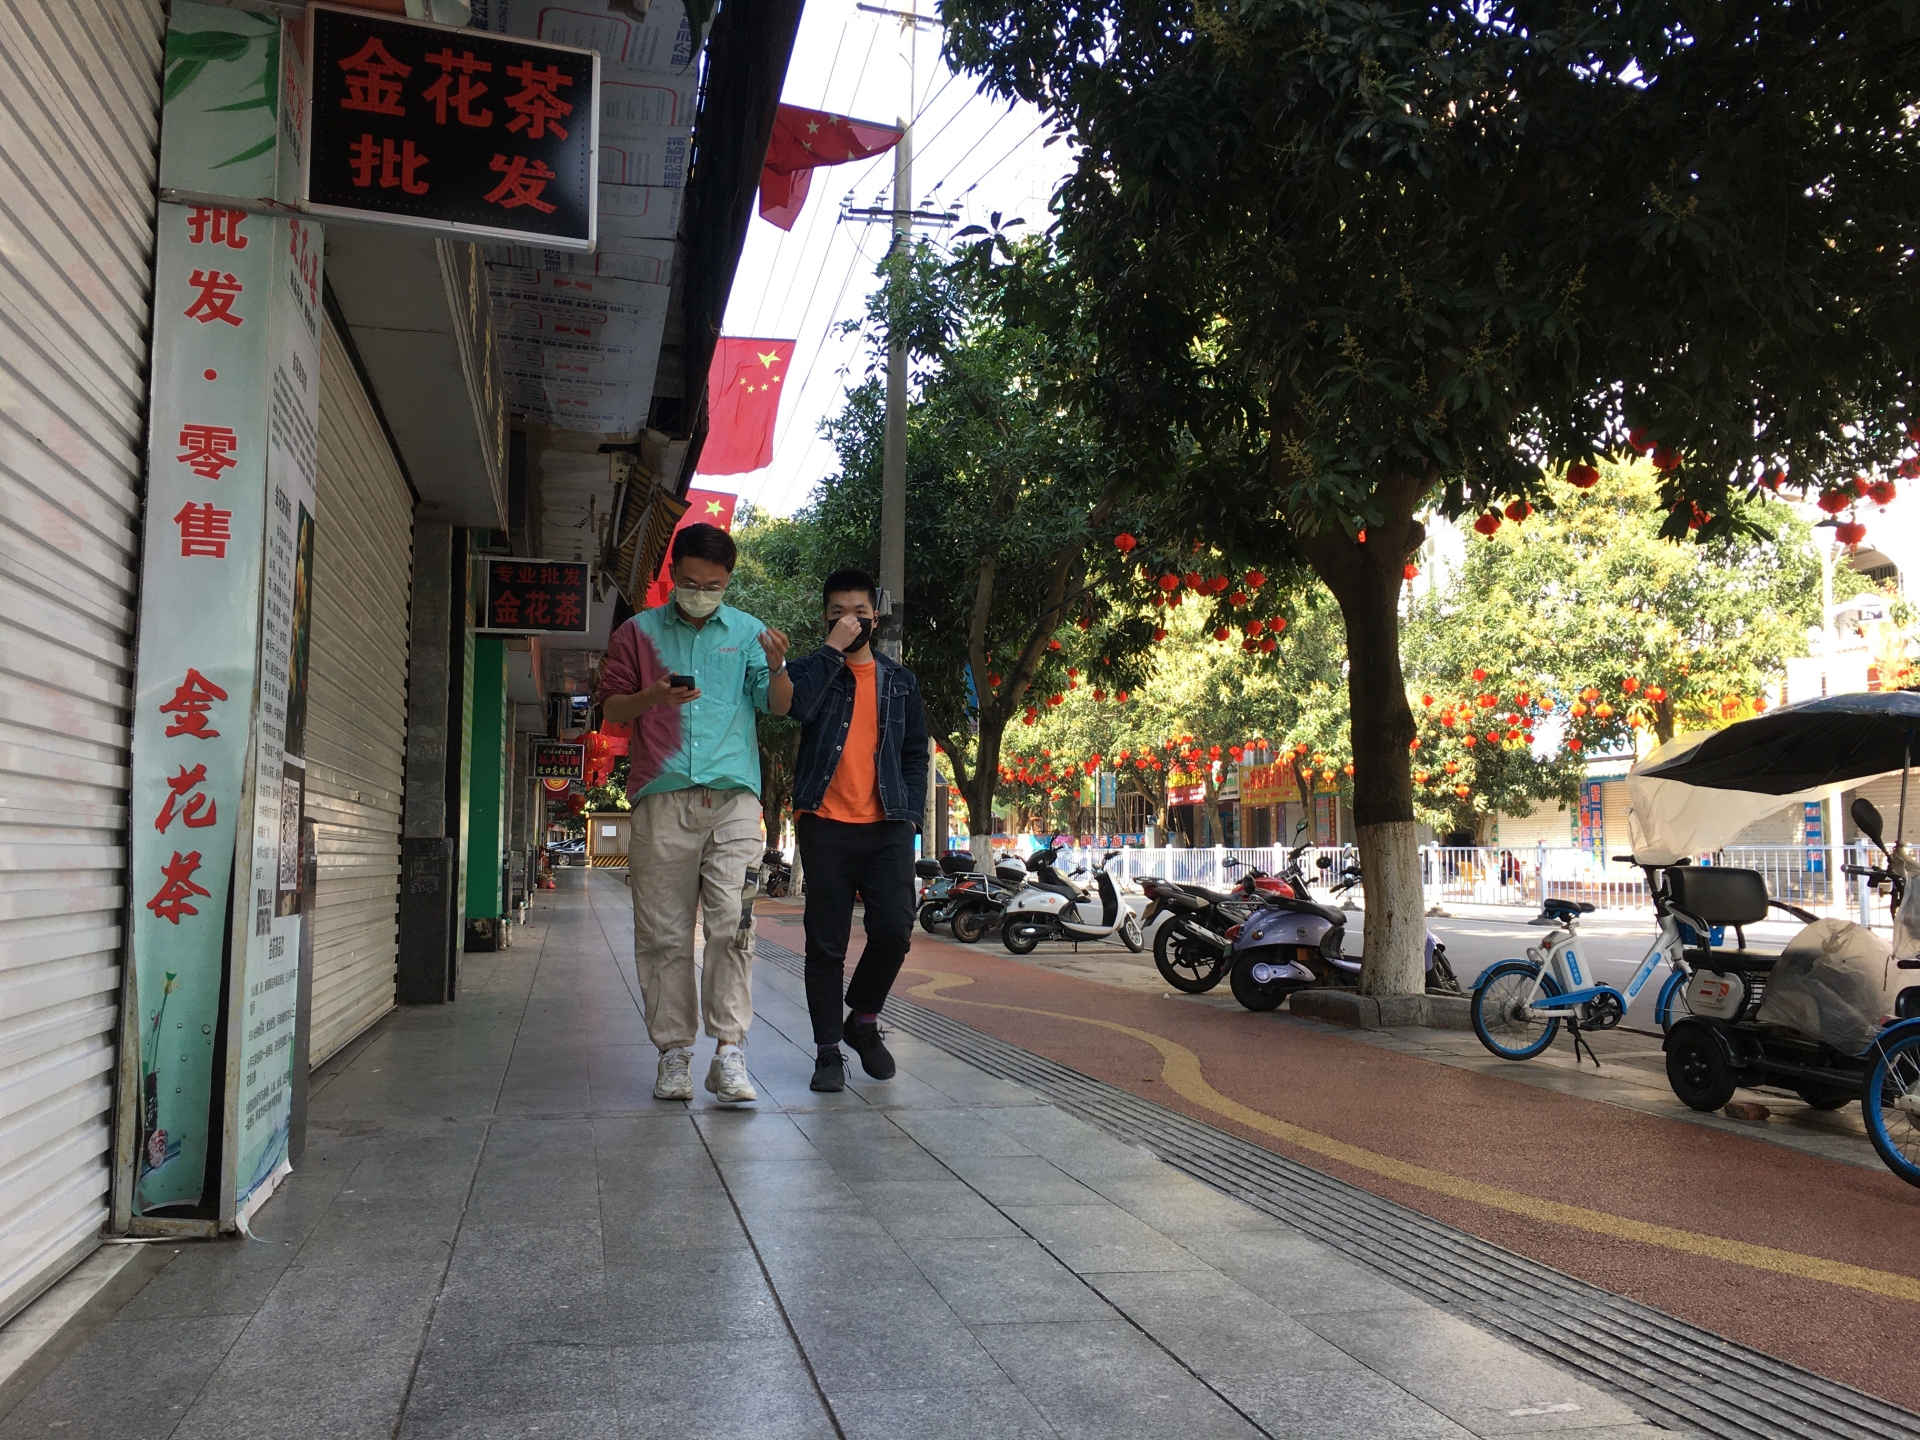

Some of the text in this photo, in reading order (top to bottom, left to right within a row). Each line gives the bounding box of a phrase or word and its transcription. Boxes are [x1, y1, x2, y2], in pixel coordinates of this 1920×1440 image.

[337, 36, 573, 141] 金花茶
[349, 134, 558, 214] 批发
[494, 564, 581, 586] 专业批发
[494, 590, 581, 626] 金花茶
[146, 667, 229, 925] 金花茶
